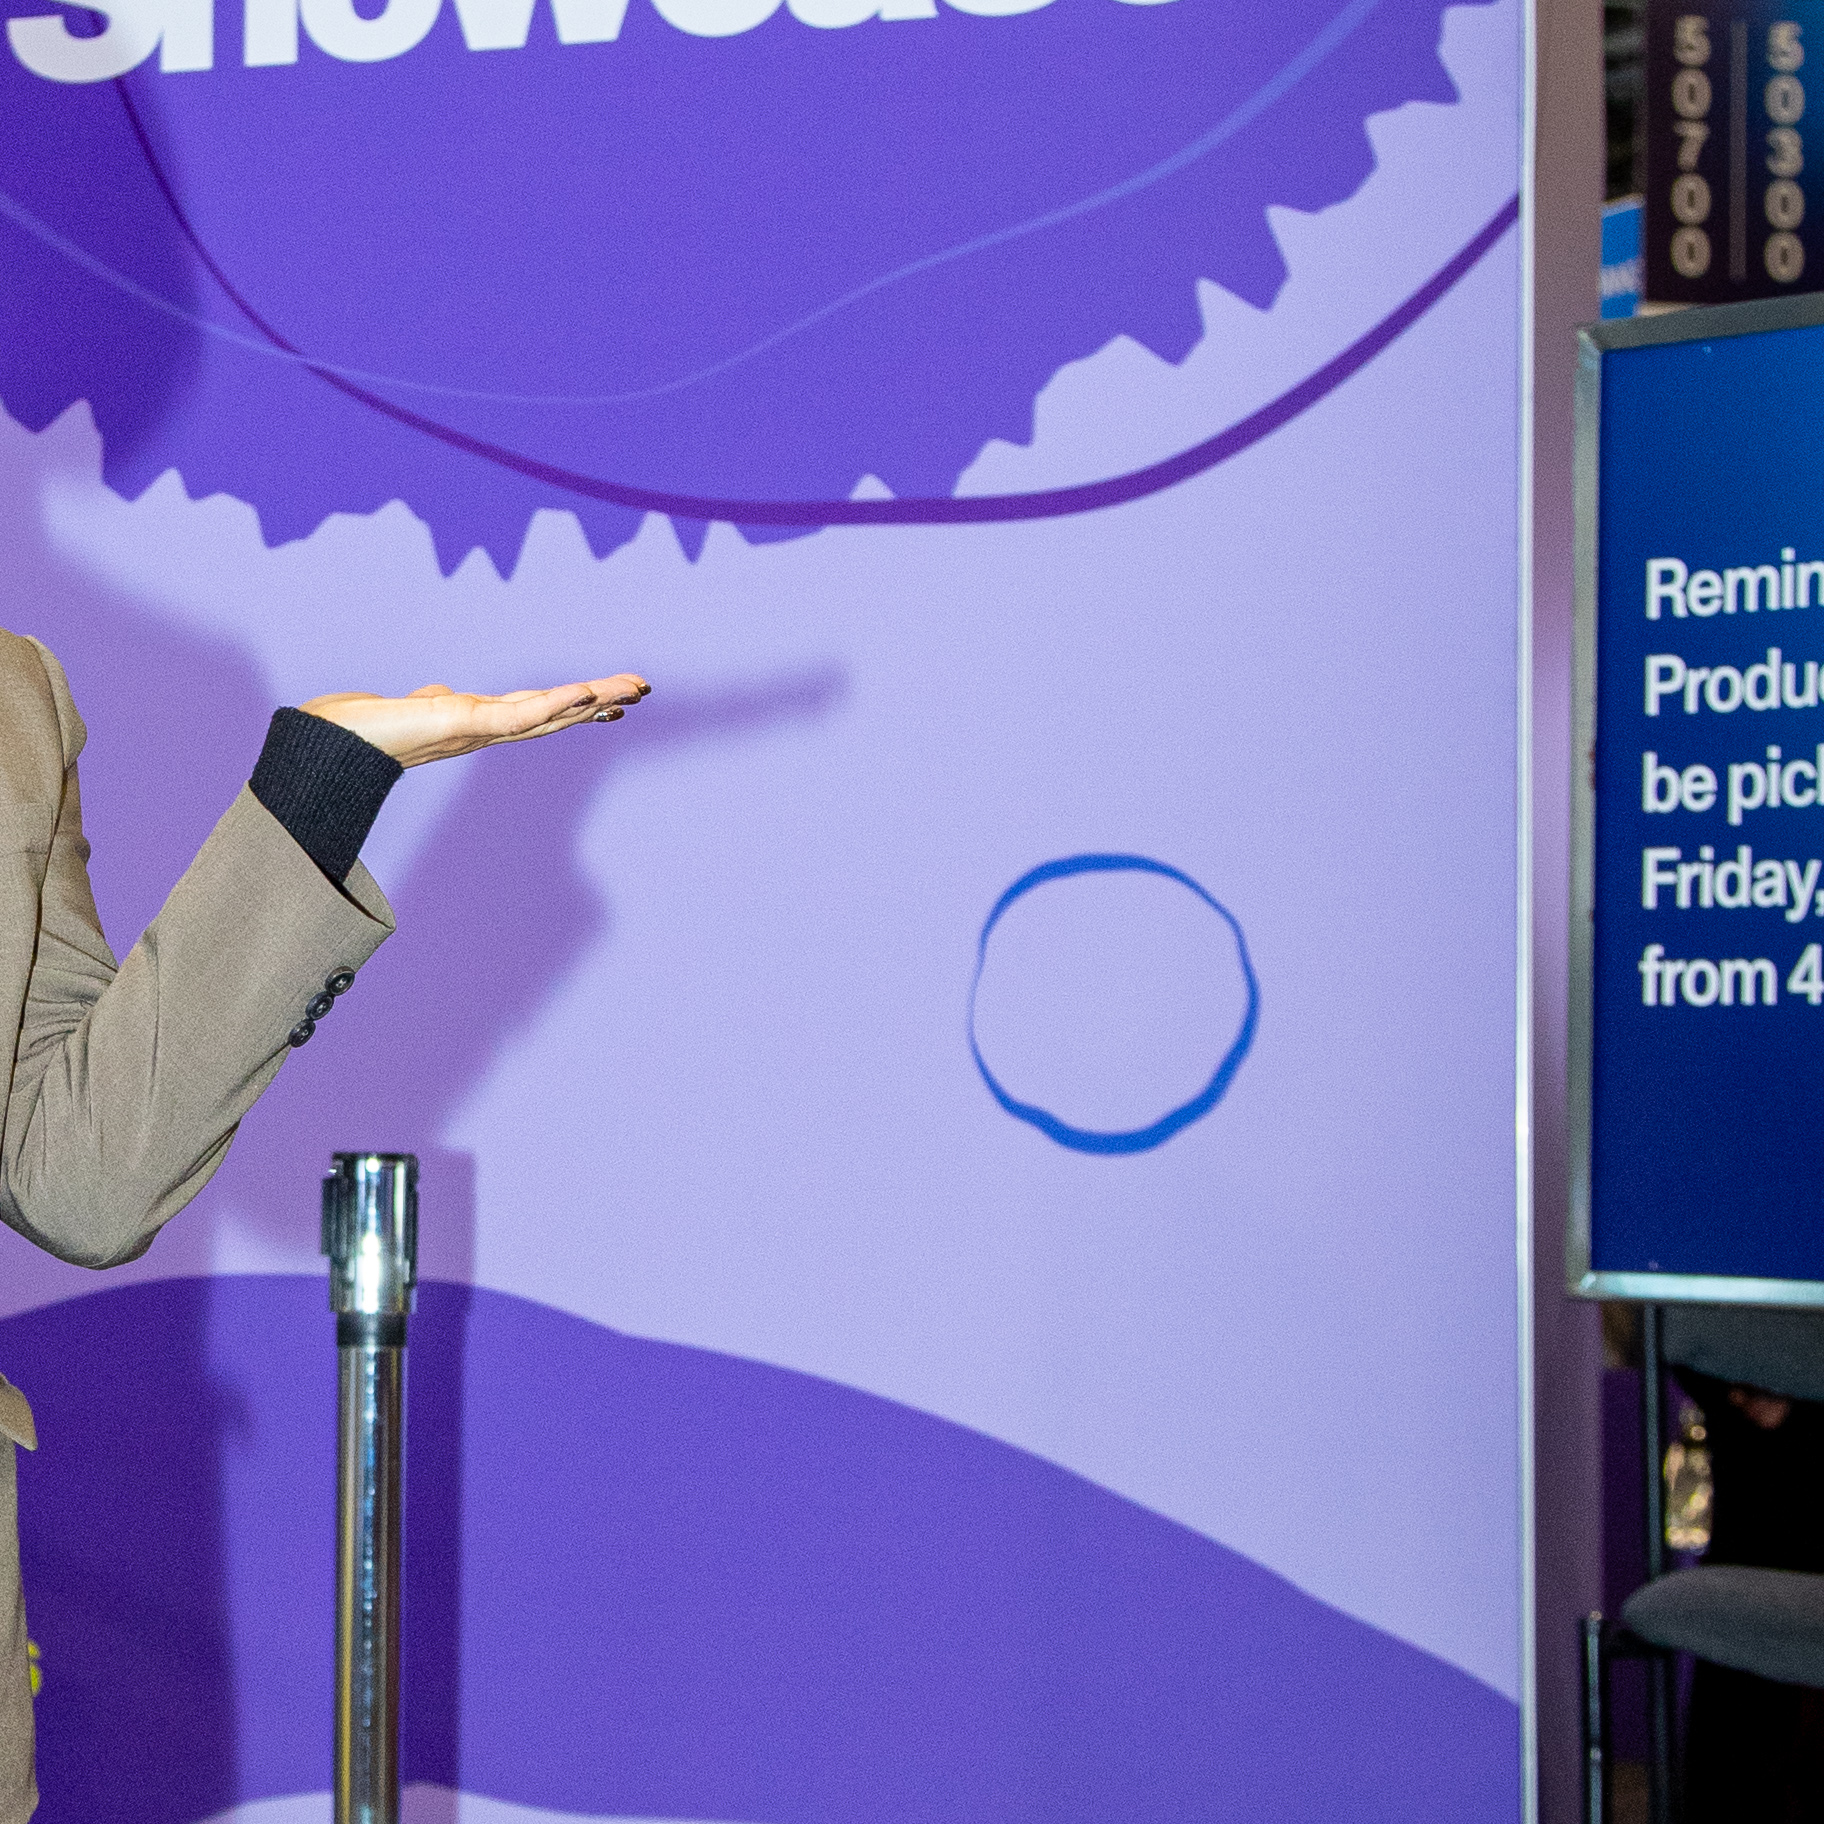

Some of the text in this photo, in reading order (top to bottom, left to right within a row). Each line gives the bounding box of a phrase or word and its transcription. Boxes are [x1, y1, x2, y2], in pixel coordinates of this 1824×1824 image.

[1671, 13, 1713, 279] 50700
[1644, 545, 1824, 621] Remin
[1643, 646, 1824, 717] Produ
[1641, 742, 1824, 826] be pic
[1641, 844, 1824, 924] Friday,
[1639, 941, 1778, 1008] from
